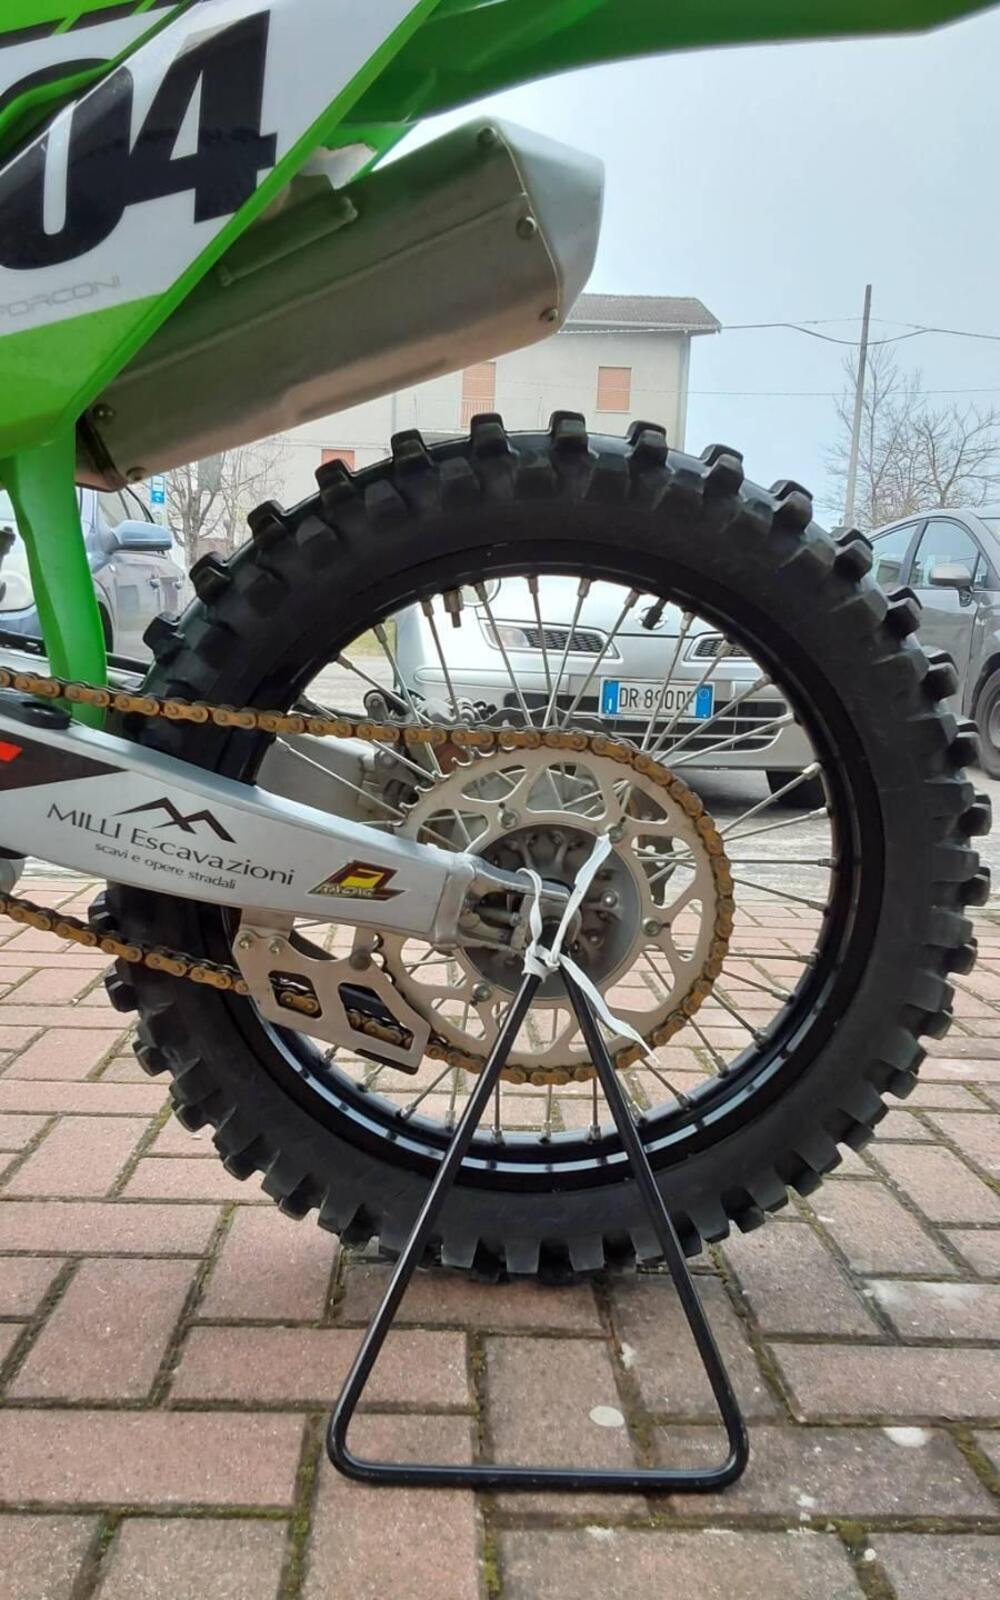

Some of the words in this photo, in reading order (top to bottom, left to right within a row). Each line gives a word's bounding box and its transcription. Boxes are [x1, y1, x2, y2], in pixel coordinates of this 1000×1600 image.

[619, 687, 639, 708] DR
[47, 802, 122, 839] MILLI
[130, 827, 296, 886] Escavazioni
[94, 843, 129, 859] scavi
[131, 854, 142, 863] e
[144, 858, 185, 876] opere
[187, 870, 237, 890] stradali
